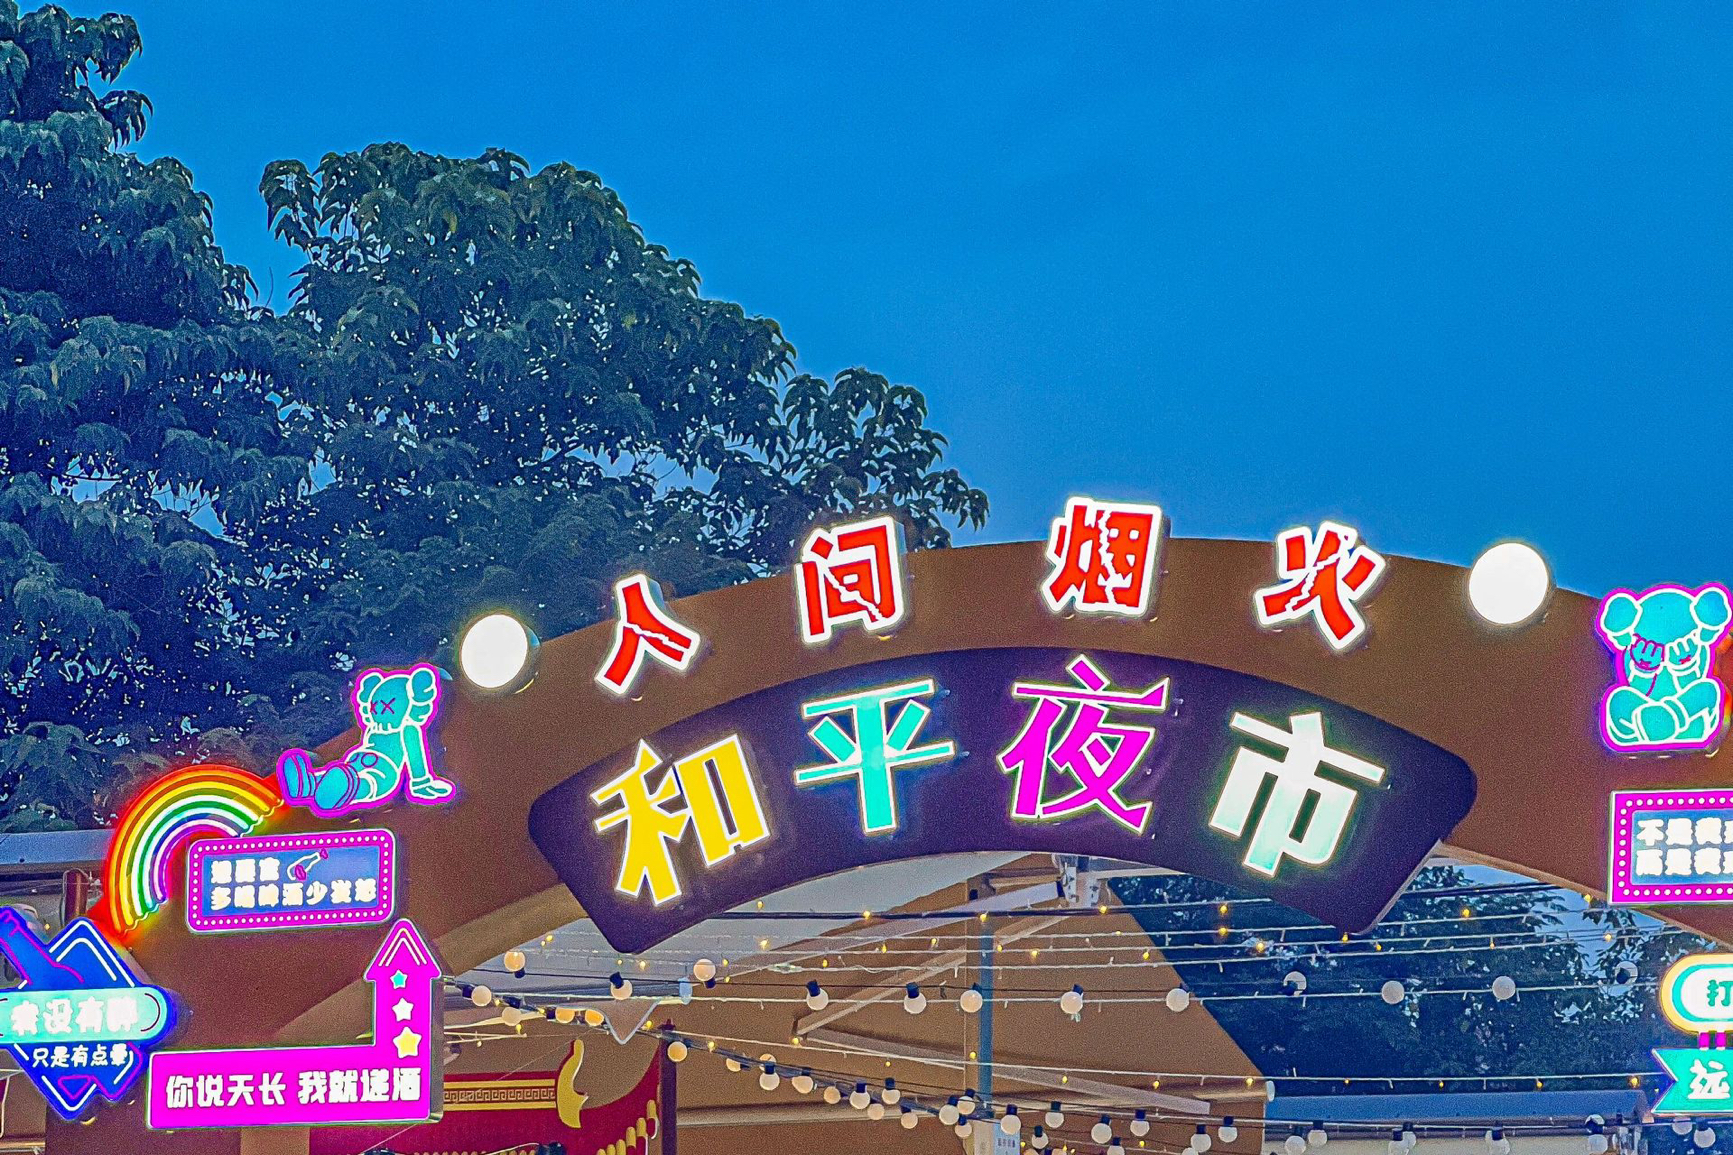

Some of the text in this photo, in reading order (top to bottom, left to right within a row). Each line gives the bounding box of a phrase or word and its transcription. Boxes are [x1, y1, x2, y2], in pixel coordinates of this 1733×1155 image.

[595, 495, 1387, 696] 人间烟火
[590, 655, 1385, 907] 和平夜市
[32, 1043, 128, 1068] 只是有点晕
[166, 1067, 422, 1108] 你说天长 我就递酒
